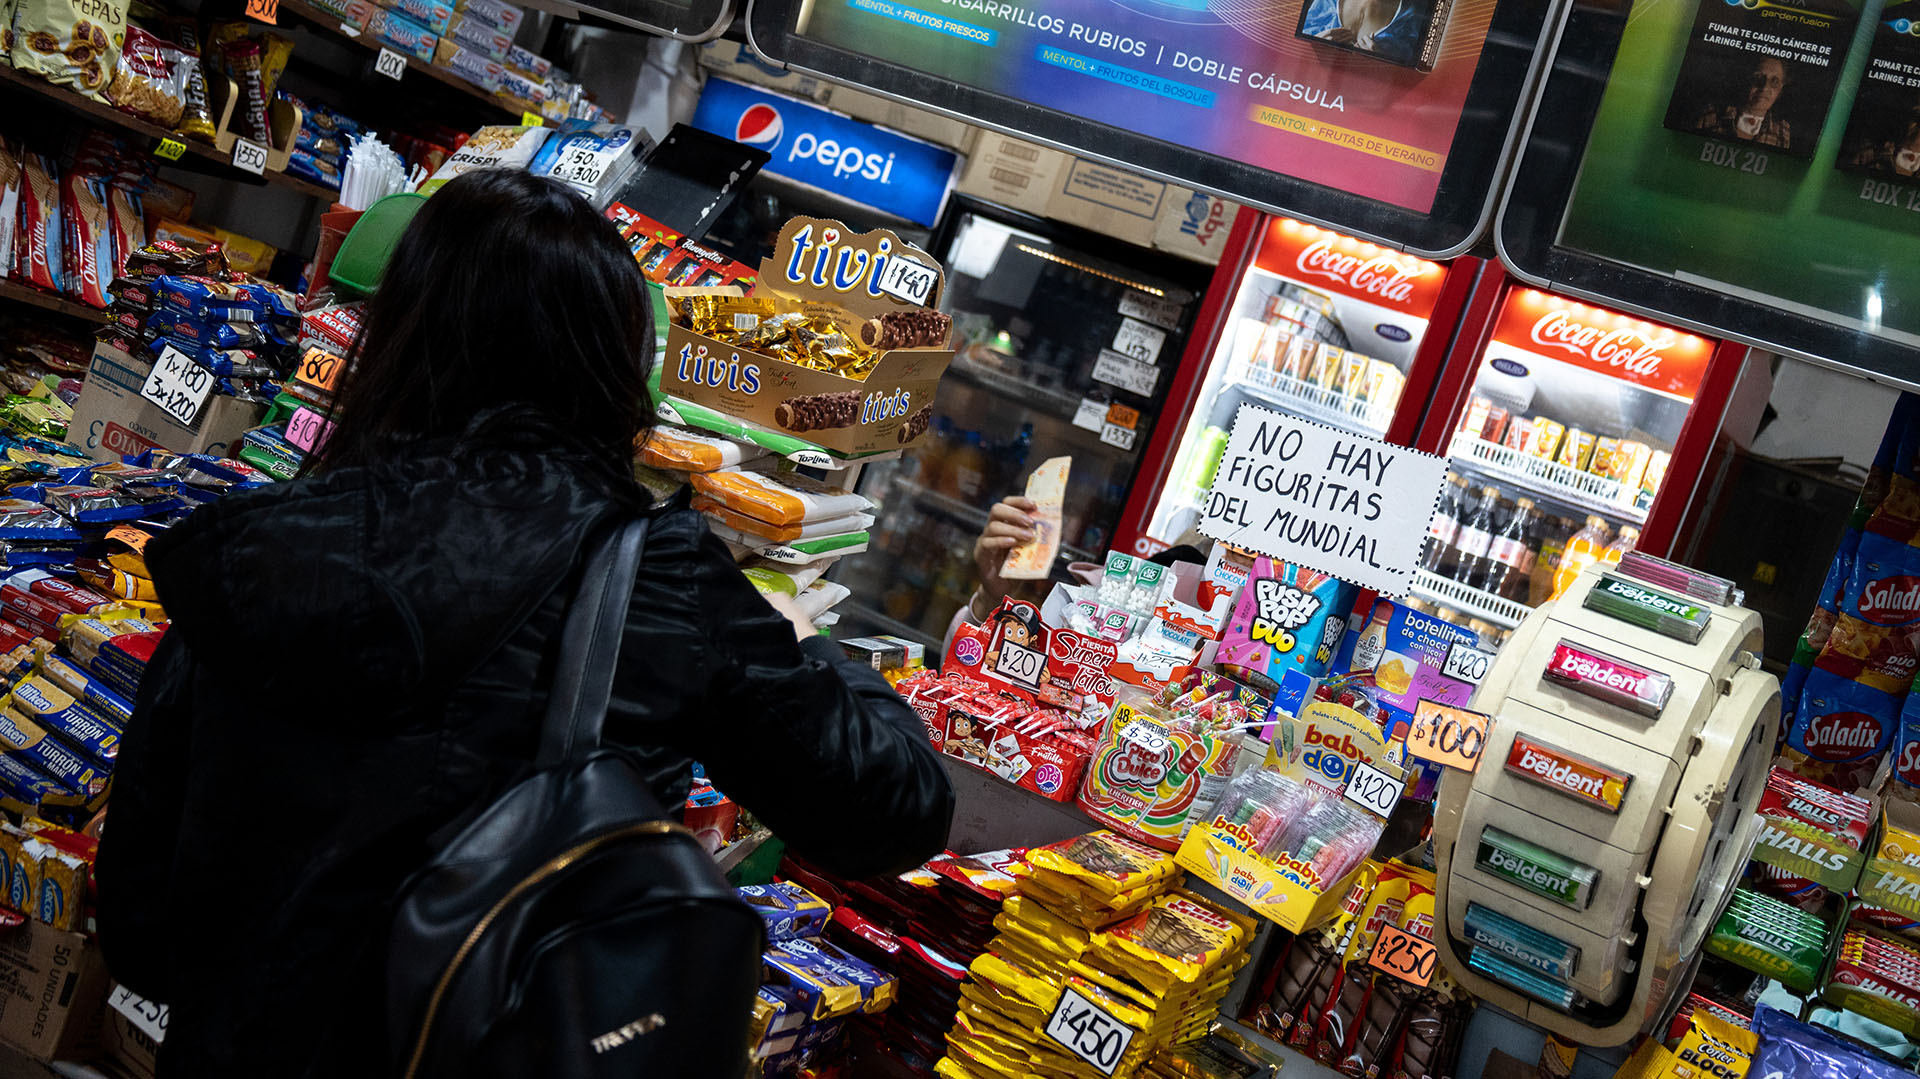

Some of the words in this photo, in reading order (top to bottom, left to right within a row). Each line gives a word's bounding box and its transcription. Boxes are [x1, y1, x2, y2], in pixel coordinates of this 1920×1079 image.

[71, 0, 122, 25] PEPAS
[903, 10, 943, 29] FRUTOS
[944, 21, 990, 42] FRESCOS
[1760, 9, 1799, 29] garden
[1800, 15, 1830, 29] fusion
[1703, 34, 1744, 51] LARINGE,
[1745, 42, 1793, 60] ESTÓMAGO
[1793, 53, 1800, 61] Y
[1800, 53, 1829, 67] RIÑÓN
[1708, 22, 1740, 36] FUMAR
[1740, 29, 1751, 38] TE
[1752, 31, 1781, 45] CAUSA
[1782, 36, 1818, 53] CÁNCER
[1819, 45, 1832, 55] DE
[1043, 49, 1088, 71] MENTOL
[1096, 65, 1139, 85] FRUTOS
[1141, 77, 1162, 91] DEL
[1163, 83, 1209, 105] BOSQUE
[1069, 23, 1147, 57] RUBIOS
[1173, 51, 1244, 85] DOBLE
[1248, 72, 1346, 112] CÁPSULA
[1868, 70, 1905, 86] LARINGE,
[1873, 58, 1901, 73] FUMAR
[1902, 64, 1914, 74] TE
[1260, 110, 1308, 133] MENTOL
[1319, 126, 1364, 148] FRUTAS
[1366, 138, 1384, 153] DE
[1385, 145, 1436, 168] VERANO
[450, 152, 502, 167] CRISPY
[788, 133, 895, 184] pepsi
[1700, 142, 1736, 169] BOX
[1741, 151, 1768, 175] 20
[1860, 178, 1901, 208] BOX
[888, 262, 930, 299] $140
[677, 341, 761, 395] tivis
[861, 387, 912, 426] tivis
[1249, 421, 1304, 462] NO
[1326, 440, 1395, 487] HAY
[1208, 491, 1251, 529] DEL
[1217, 558, 1248, 580] Kinder
[1256, 579, 1320, 617] PUSH
[1608, 581, 1690, 616] beldent
[1860, 581, 1920, 611] Saladi
[1161, 620, 1187, 636] Kinder
[1260, 599, 1308, 629] POP
[1080, 637, 1116, 656] FIERITA
[1156, 627, 1192, 647] CHOCOLATE
[1251, 617, 1296, 653] DUO
[1401, 627, 1416, 639] de
[1409, 640, 1424, 651] con
[1425, 644, 1443, 658] licor
[1002, 646, 1037, 677] $20
[1051, 631, 1114, 669] Super
[1449, 647, 1489, 681] $120
[1560, 655, 1648, 695] beldent
[912, 698, 939, 711] FIERITA
[1117, 708, 1131, 723] 48
[1312, 709, 1330, 720] Paleta
[60, 709, 105, 741] TURRÓN
[1126, 726, 1165, 750] $30
[1806, 716, 1880, 748] Saladix
[37, 740, 82, 776] TURRÓN
[1303, 722, 1373, 764] baby
[1116, 755, 1161, 780] Dulce
[1519, 751, 1605, 797] beldent
[1353, 770, 1398, 810] $120
[1787, 797, 1841, 826] HALLS
[1212, 815, 1258, 849] baby
[1758, 825, 1849, 872] HALLS
[1233, 866, 1258, 886] baby
[1275, 852, 1321, 885] baby
[1489, 848, 1571, 894] beldent
[1474, 929, 1551, 971] beldent
[1741, 924, 1794, 953] HALLS
[53, 944, 71, 967] 50
[1377, 934, 1439, 981] $250
[31, 968, 62, 1040] UNIDADES
[1857, 977, 1920, 1009] HALLS
[1056, 1000, 1124, 1068] $450
[1678, 1047, 1742, 1079] BLOCK
[1698, 1043, 1737, 1066] Cofler
